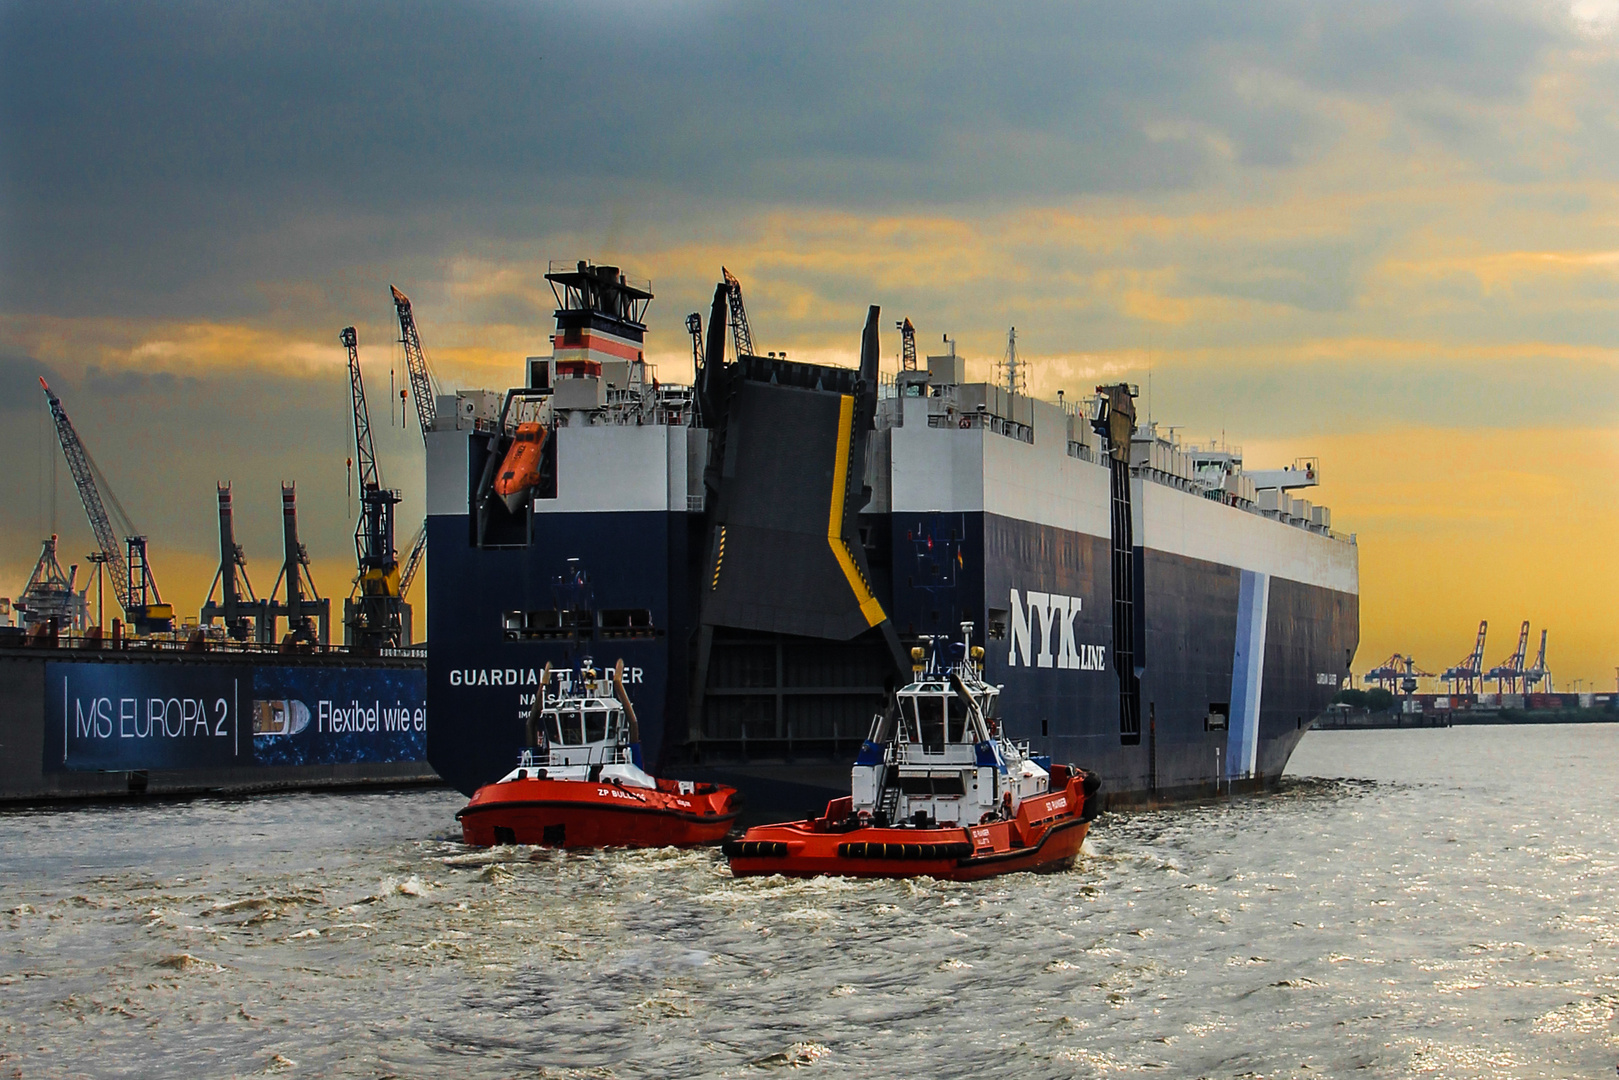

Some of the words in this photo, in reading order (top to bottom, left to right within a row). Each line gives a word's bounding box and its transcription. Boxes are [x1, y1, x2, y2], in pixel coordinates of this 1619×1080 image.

[1009, 588, 1081, 669] NYK
[1081, 644, 1105, 670] LINE
[76, 697, 113, 738] MS
[120, 698, 209, 738] EUROPA
[215, 698, 228, 736] 2
[318, 700, 379, 732] Flexibel
[383, 700, 410, 732] wie
[413, 700, 427, 731] ei
